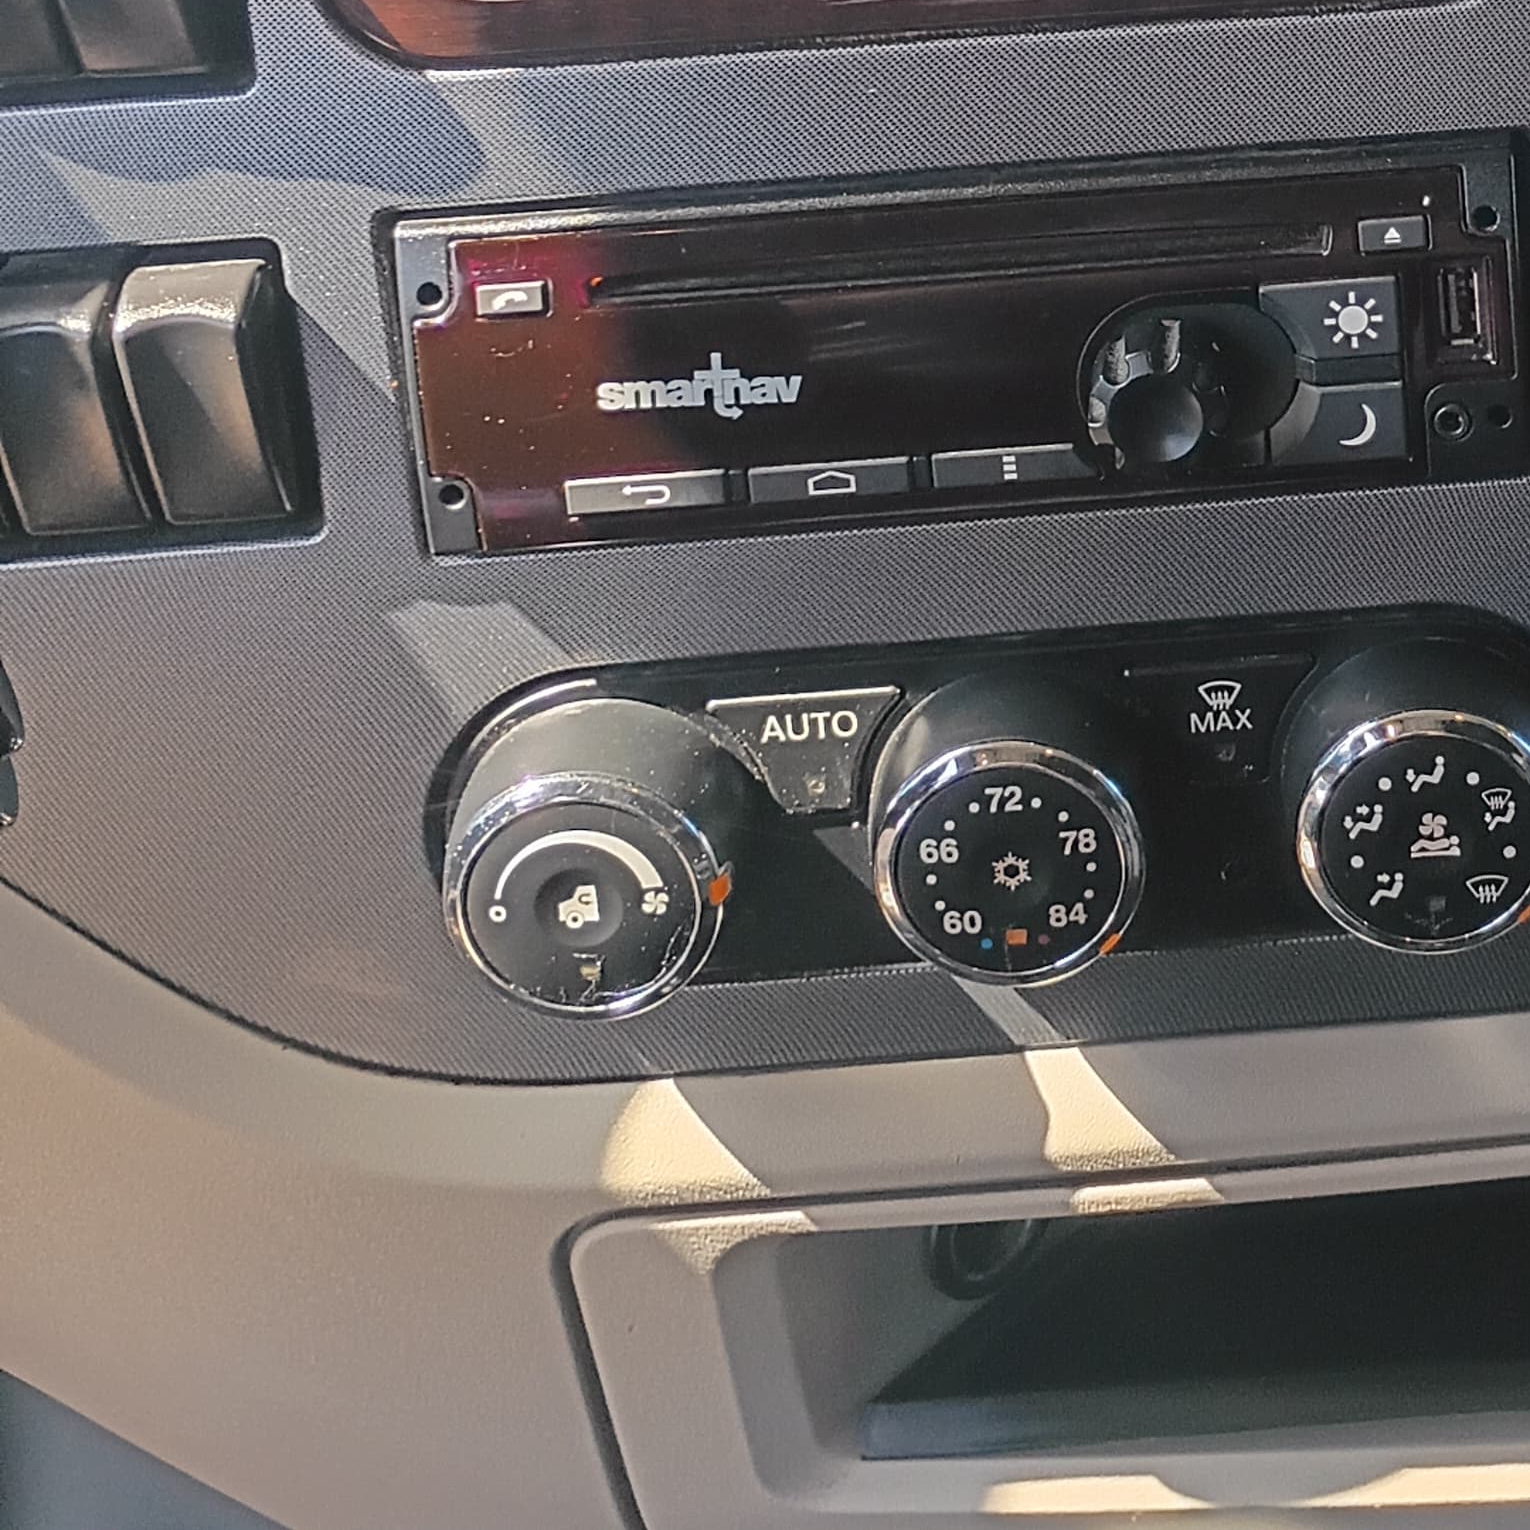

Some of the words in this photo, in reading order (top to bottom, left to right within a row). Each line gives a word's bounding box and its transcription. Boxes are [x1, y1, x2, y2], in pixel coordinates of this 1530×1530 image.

[596, 352, 802, 420] smartnav
[761, 709, 859, 743] AUTO
[1190, 708, 1253, 734] MAX
[984, 785, 1024, 814] 72
[919, 837, 960, 865] 66
[1059, 827, 1098, 856] 78
[942, 909, 983, 936] 60
[1048, 901, 1088, 928] 84
